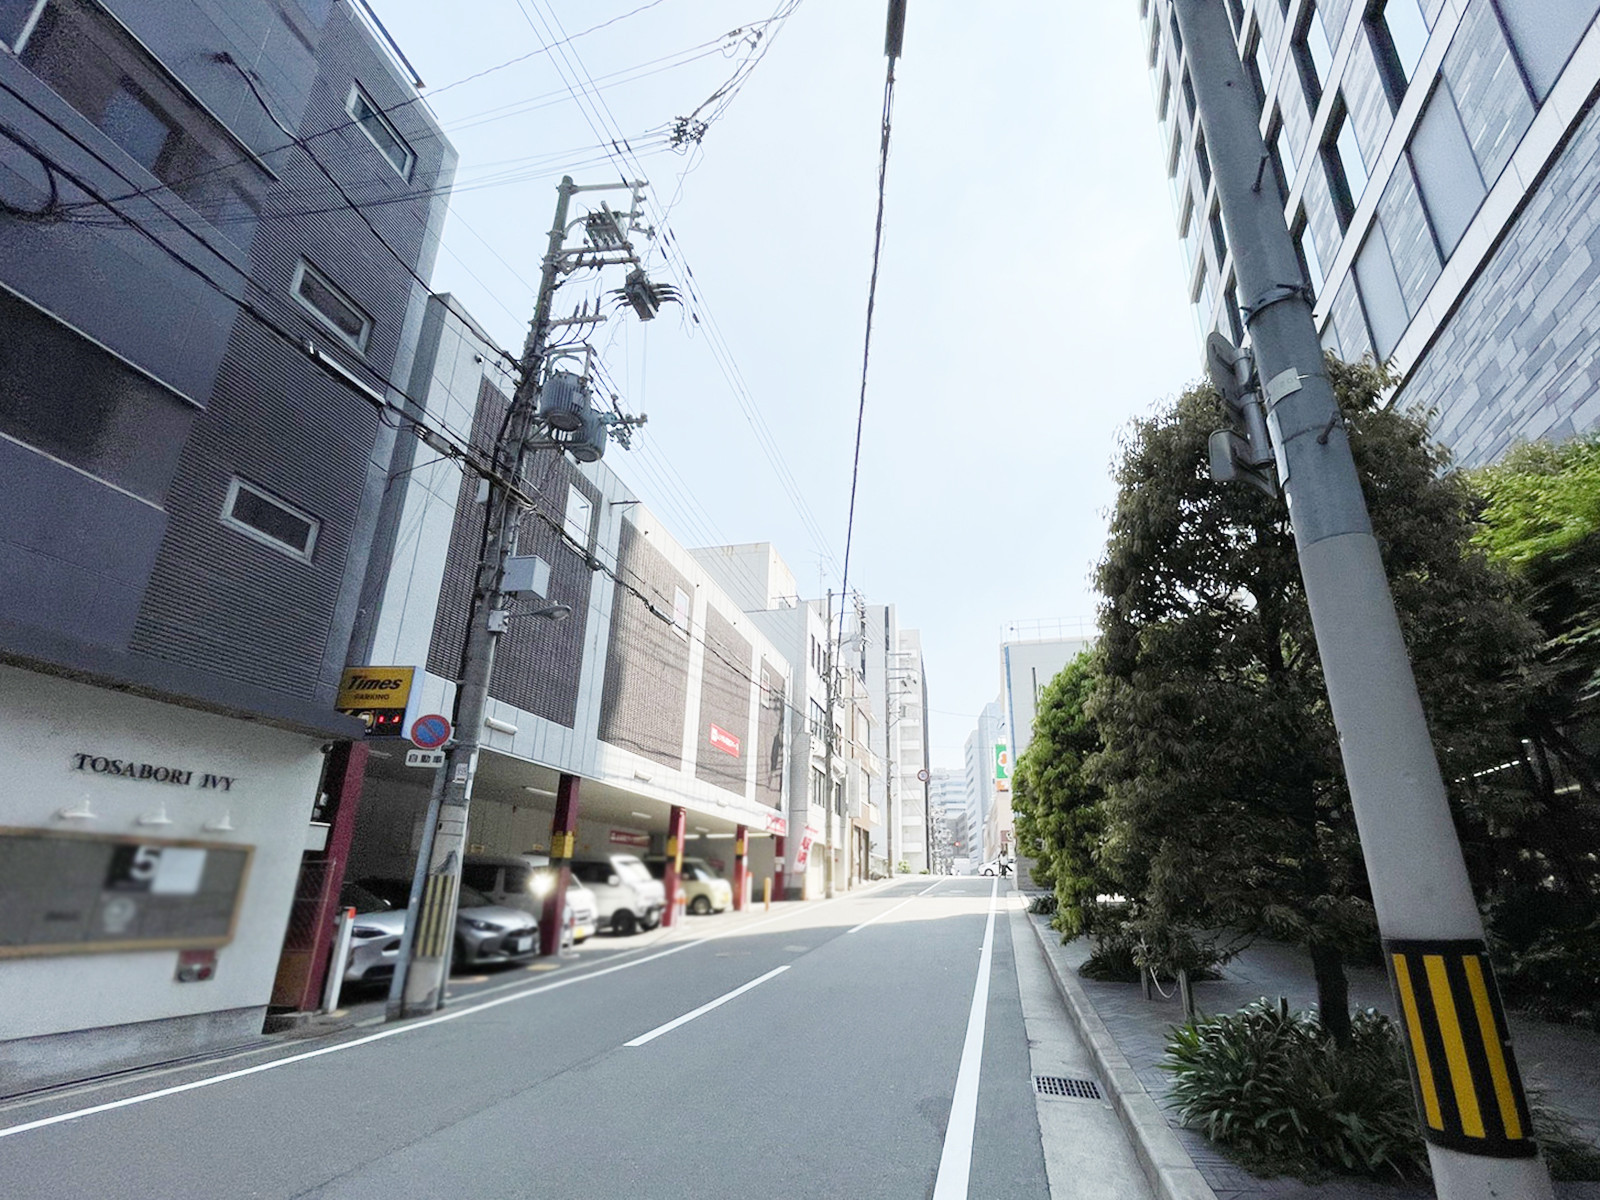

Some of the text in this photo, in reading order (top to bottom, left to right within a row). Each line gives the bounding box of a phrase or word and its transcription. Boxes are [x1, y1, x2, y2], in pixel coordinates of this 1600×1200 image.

[348, 675, 403, 691] Times
[353, 693, 390, 701] PARKING
[408, 753, 443, 764] 自動車
[74, 752, 238, 792] TOSABORI IVY
